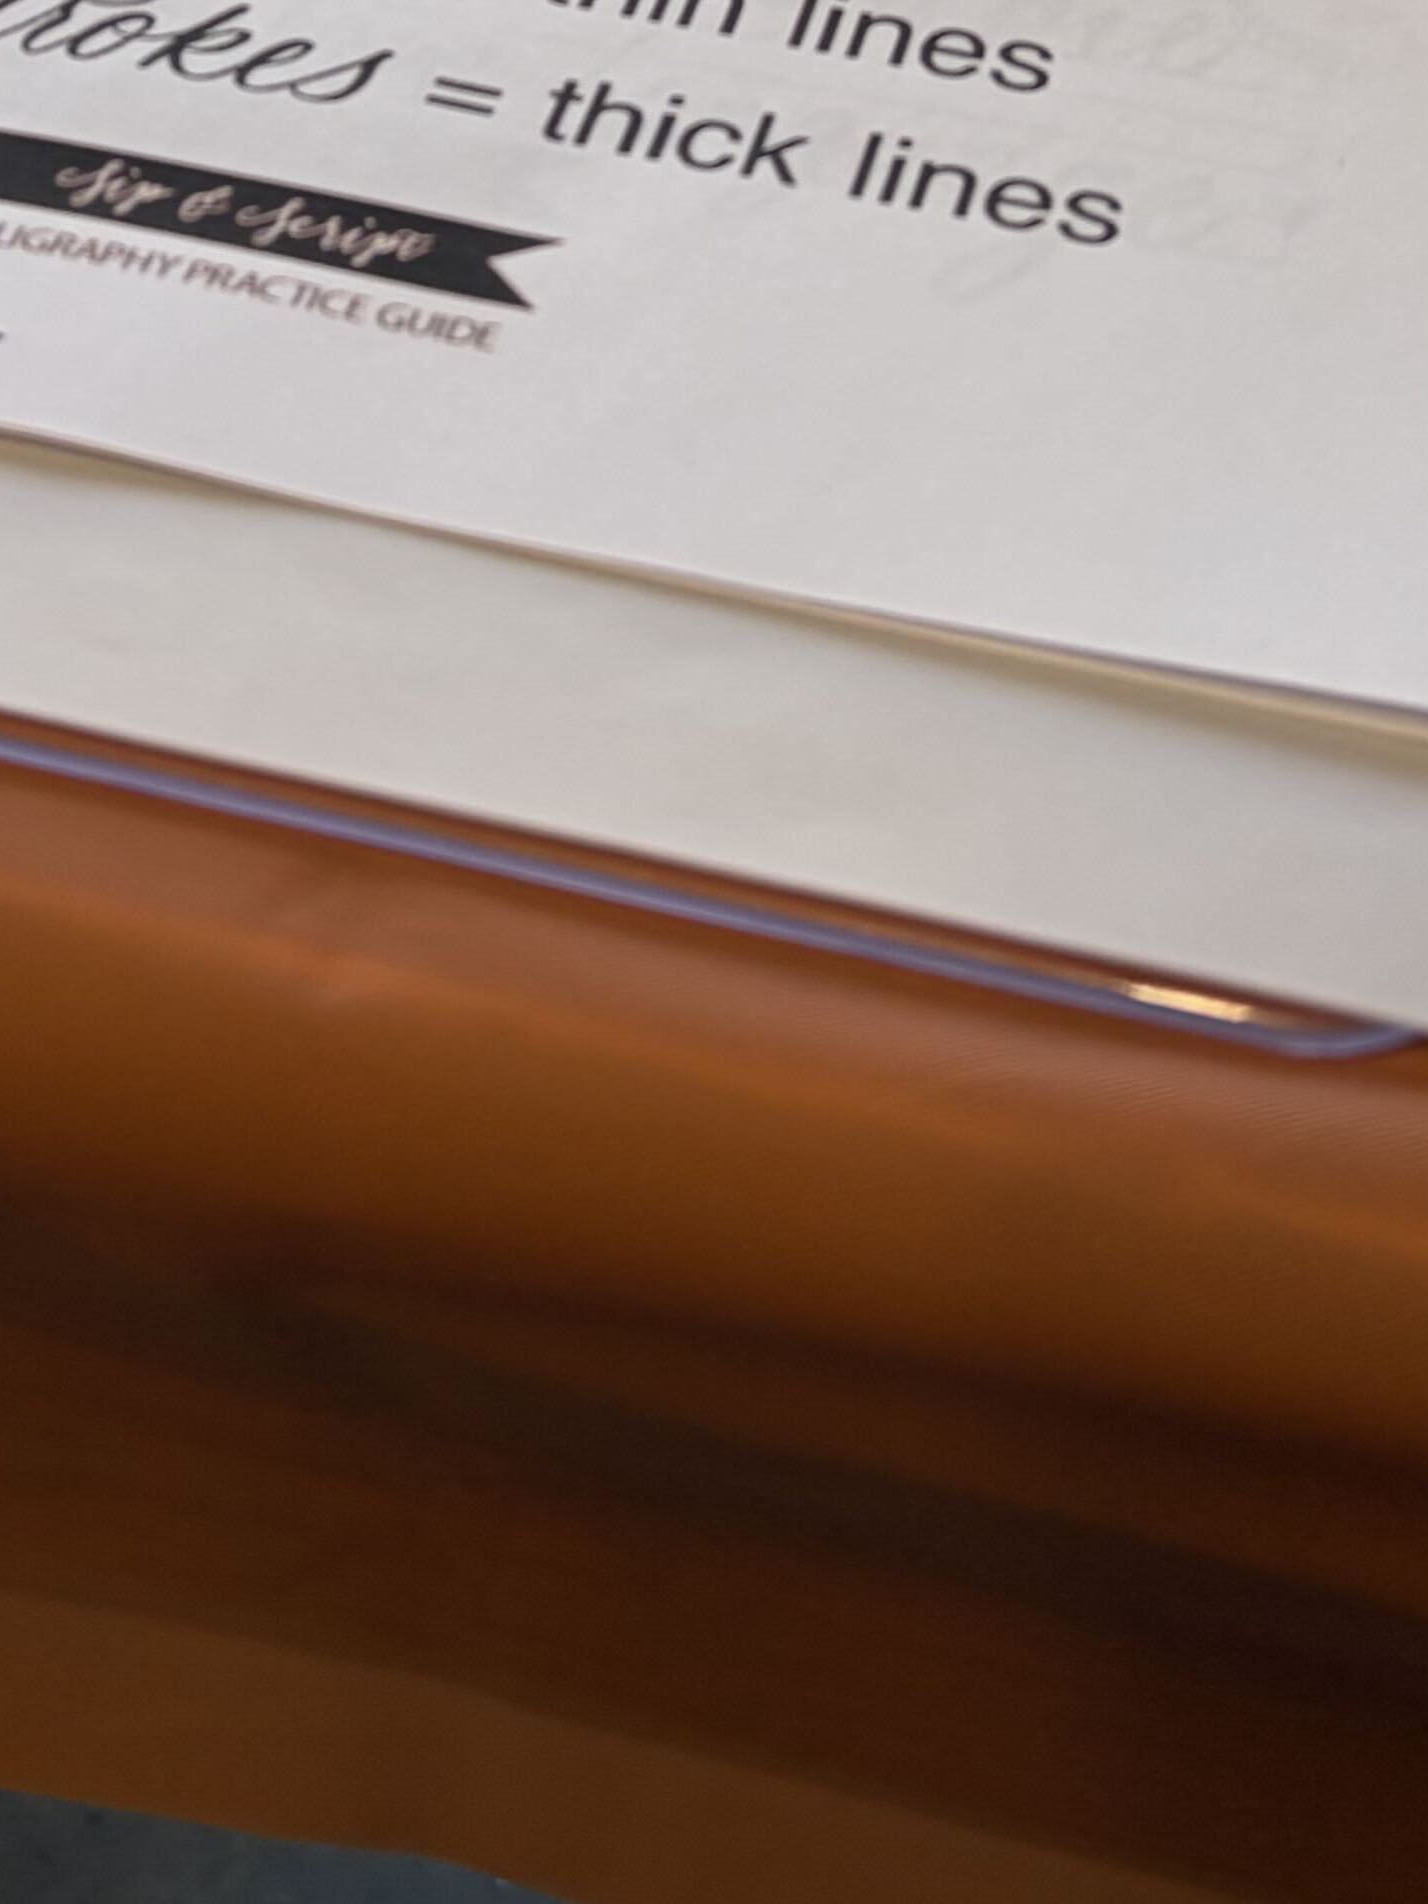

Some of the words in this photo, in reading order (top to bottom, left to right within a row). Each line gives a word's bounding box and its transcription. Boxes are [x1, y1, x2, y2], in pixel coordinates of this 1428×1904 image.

[541, 78, 811, 189] thick
[847, 129, 1124, 247] lines
[236, 196, 435, 268] Script
[181, 259, 368, 325] PRACTICE
[374, 302, 502, 354] GUIDE
